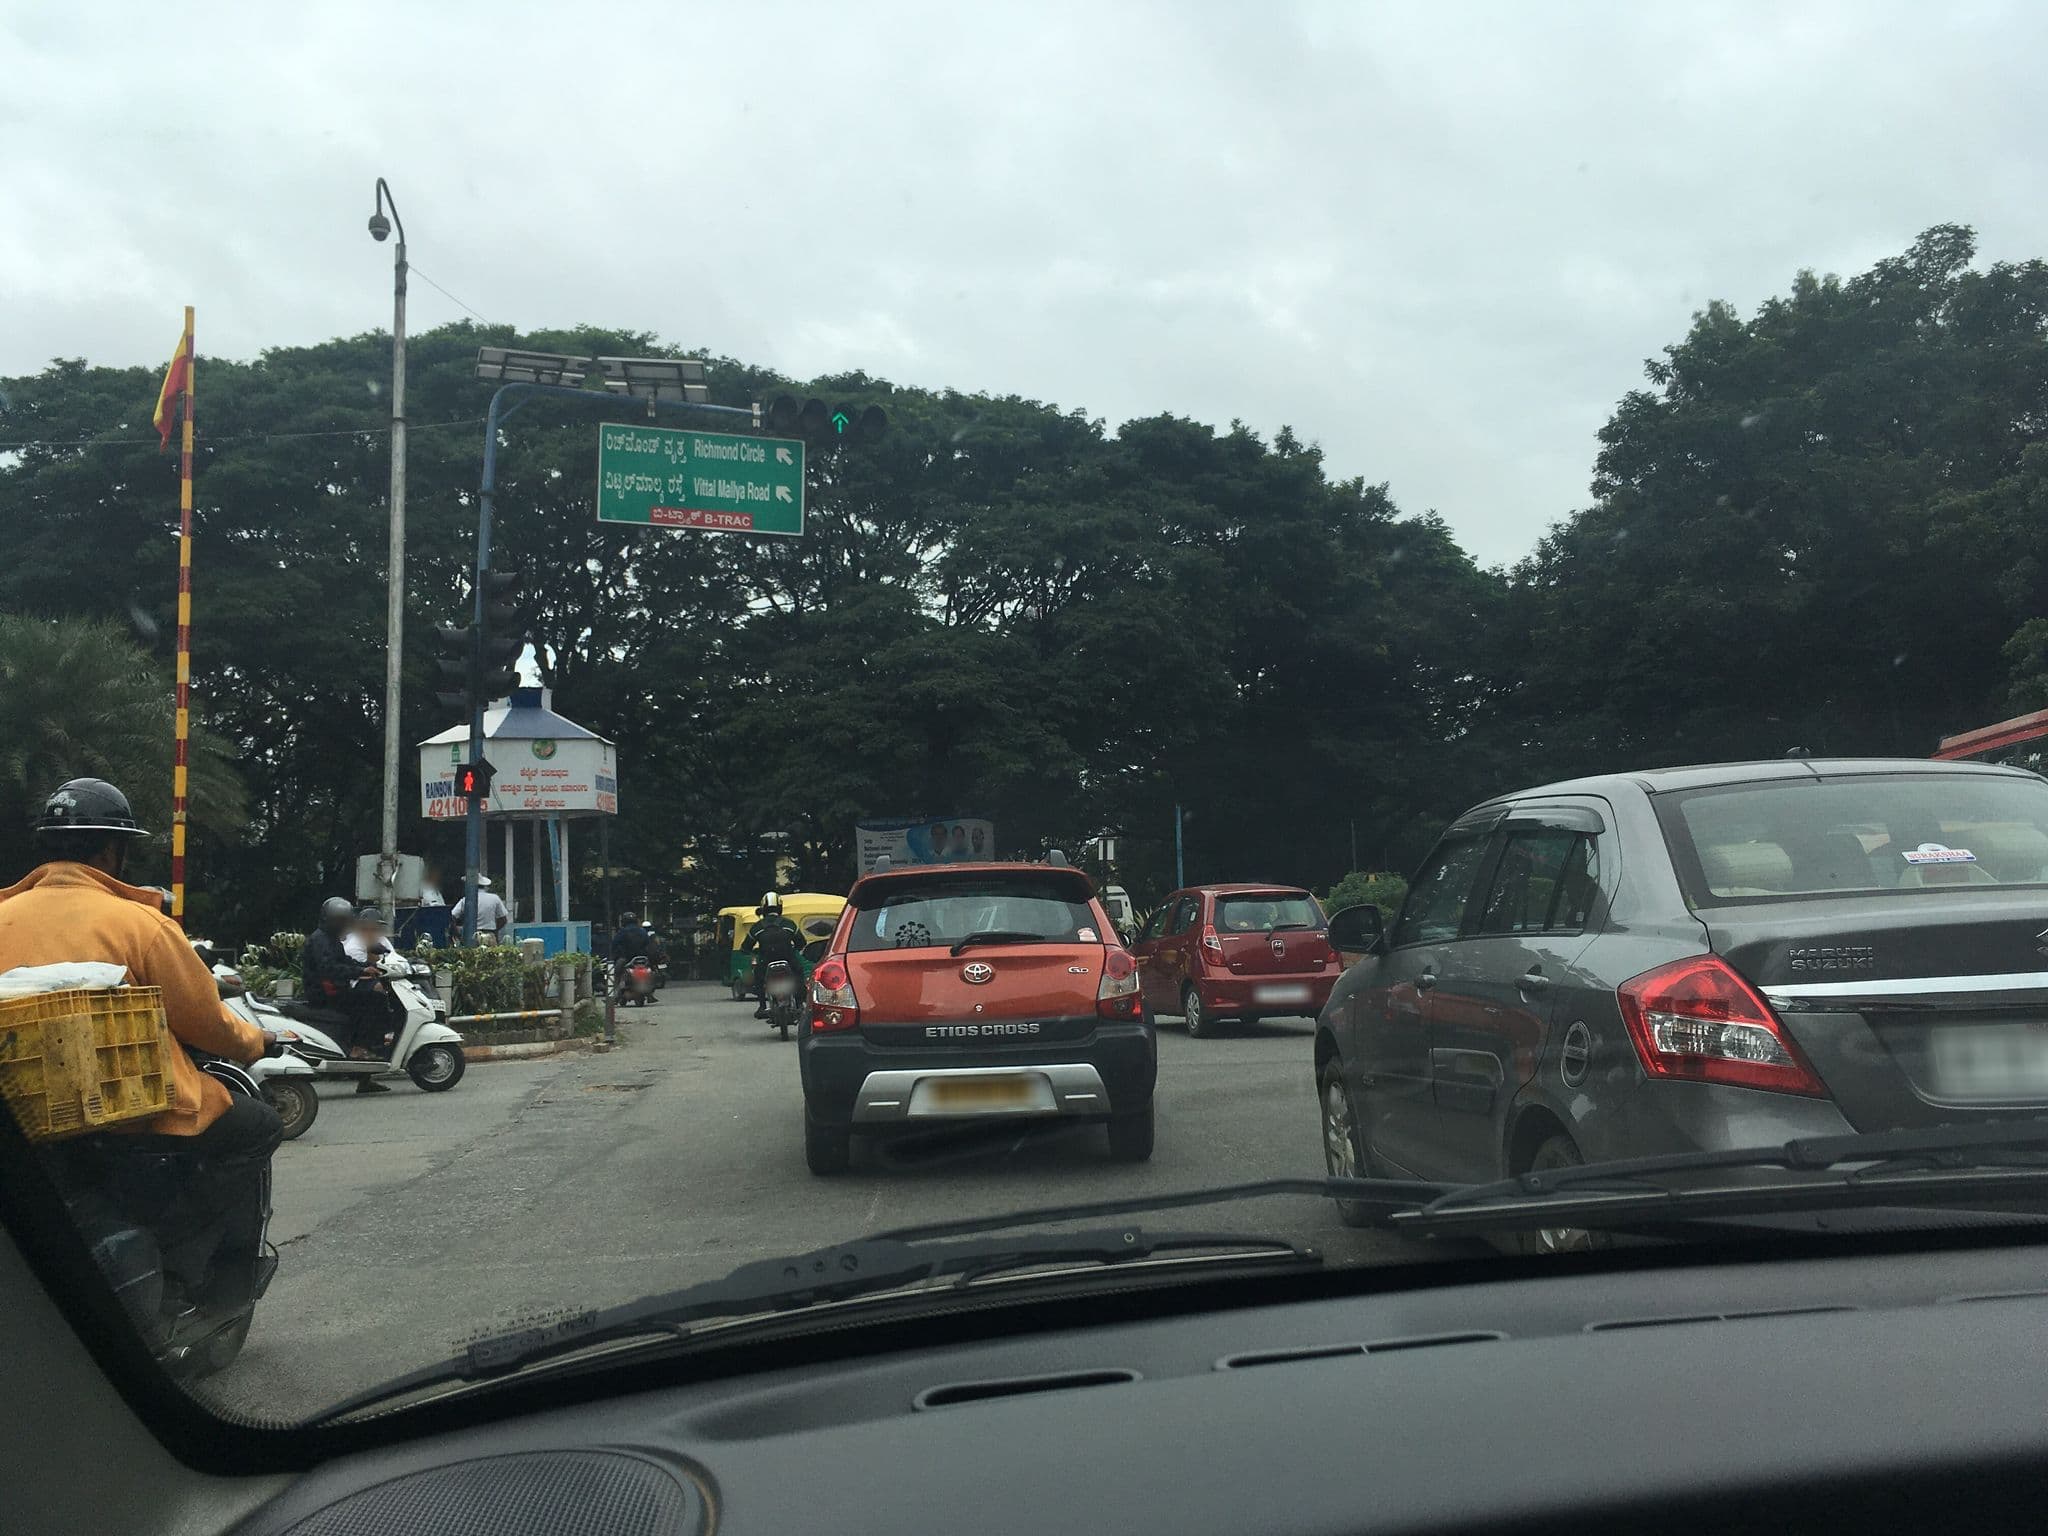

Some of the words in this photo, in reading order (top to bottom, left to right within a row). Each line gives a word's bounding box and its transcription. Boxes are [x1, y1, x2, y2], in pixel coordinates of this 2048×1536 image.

[694, 439, 738, 460] Richmond
[740, 443, 765, 463] Circle
[694, 477, 716, 497] Vittal
[718, 479, 746, 503] Mallya
[747, 482, 770, 501] Road
[704, 514, 751, 527] B-TRAC
[425, 781, 452, 798] RAINBOW
[1789, 946, 1873, 957] MARUTI
[1791, 957, 1873, 971] SUZUKI
[925, 1025, 979, 1037] ETIOS
[981, 1023, 1040, 1035] CROSS
